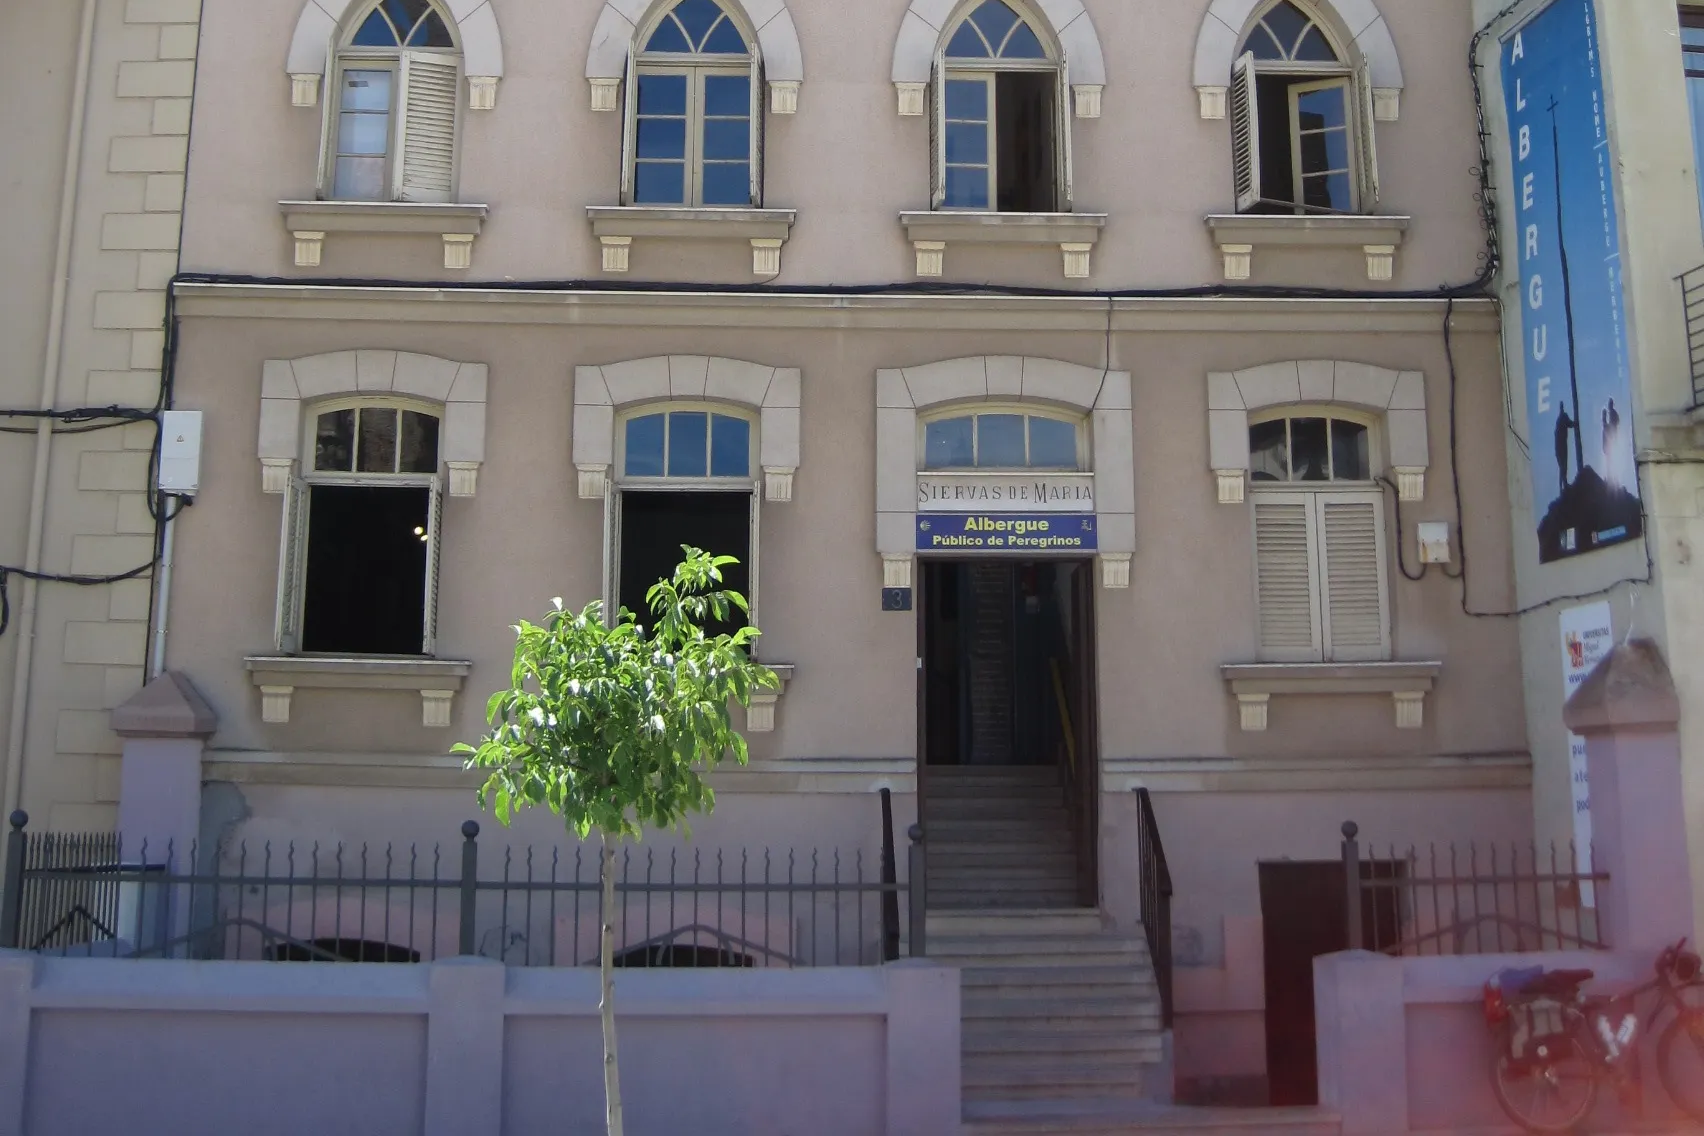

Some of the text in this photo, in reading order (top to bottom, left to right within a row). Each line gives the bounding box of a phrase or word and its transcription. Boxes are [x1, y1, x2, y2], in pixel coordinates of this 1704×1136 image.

[1510, 31, 1551, 414] ALBERGUE
[918, 481, 1092, 504] SIERVAS DE MARIA
[964, 516, 1050, 534] Albergue
[932, 535, 1082, 548] Público de Peregrinos
[891, 588, 903, 609] 3
